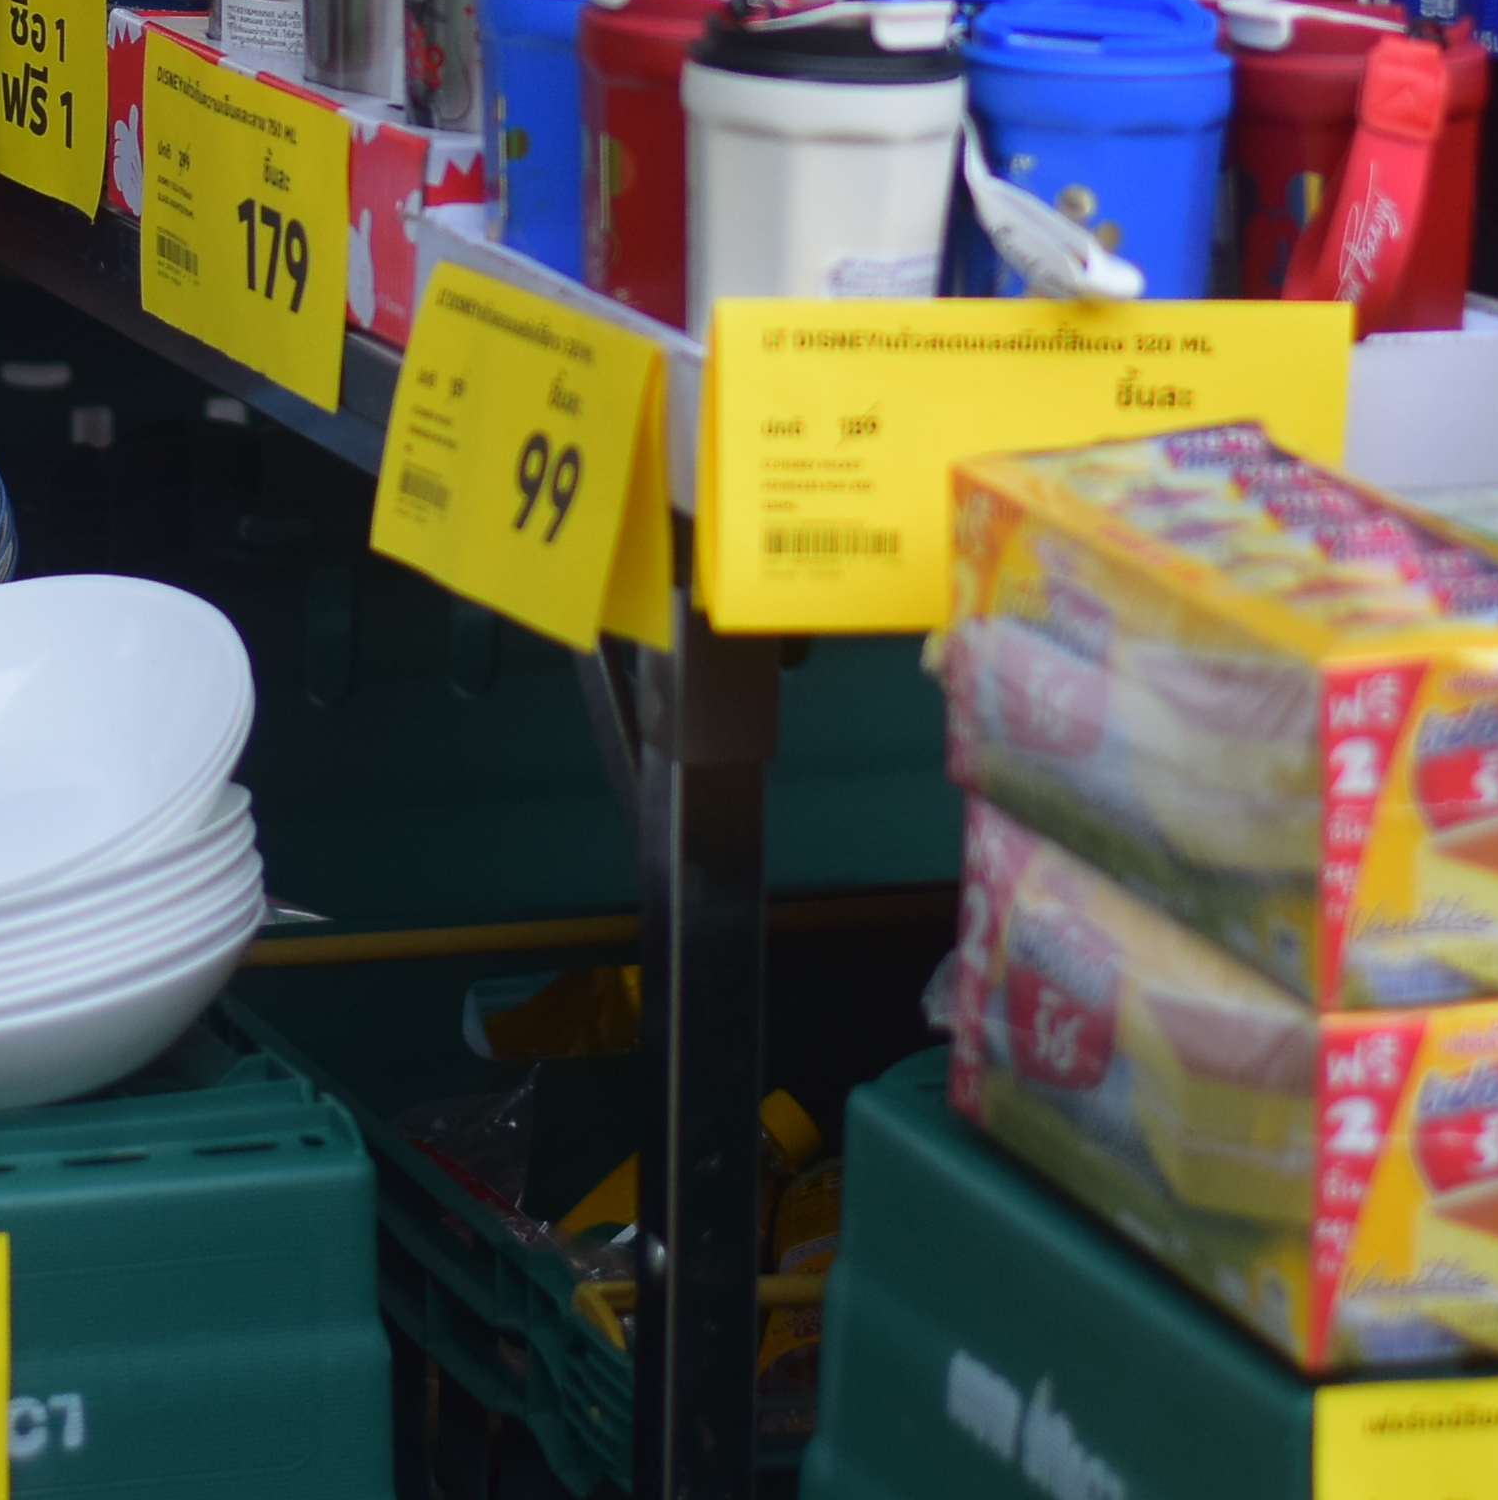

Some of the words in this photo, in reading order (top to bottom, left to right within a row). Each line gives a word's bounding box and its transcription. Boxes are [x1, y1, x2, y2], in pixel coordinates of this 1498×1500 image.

[55, 18, 66, 63] 1
[2, 62, 49, 137] ฟรี
[60, 91, 73, 150] 1
[263, 146, 292, 193] ชิ้นละ
[237, 197, 309, 315] 179
[1181, 332, 1212, 354] ML
[1115, 366, 1195, 411] ชิ้นละ
[515, 430, 582, 543] 99
[1327, 670, 1400, 728] ฟรี
[1334, 737, 1378, 794] 2
[1326, 1027, 1400, 1087] ฟรี
[1328, 1098, 1378, 1152] 2
